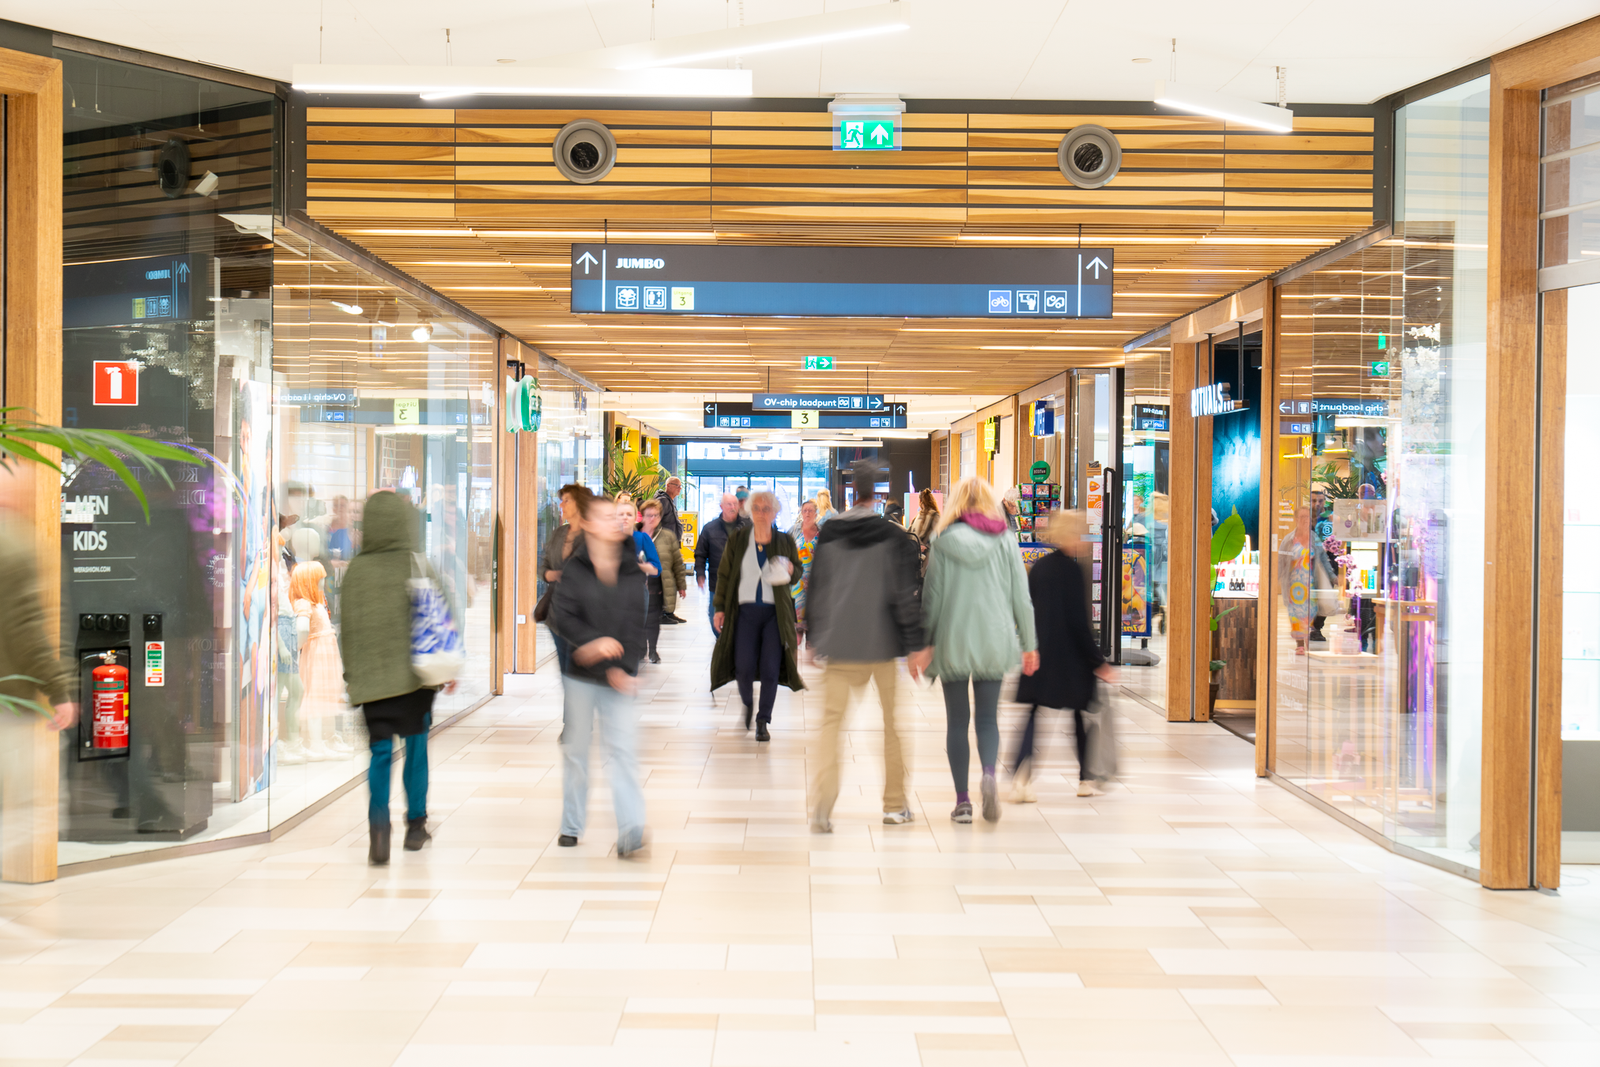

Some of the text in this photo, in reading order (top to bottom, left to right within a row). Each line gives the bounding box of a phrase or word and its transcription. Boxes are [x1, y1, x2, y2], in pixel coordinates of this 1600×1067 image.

[615, 258, 665, 269] JUMBO
[679, 296, 686, 306] 3
[764, 398, 837, 408] OV-chip laadpunt
[801, 413, 809, 425] 3
[75, 495, 109, 515] MEN
[73, 530, 108, 551] KIDS
